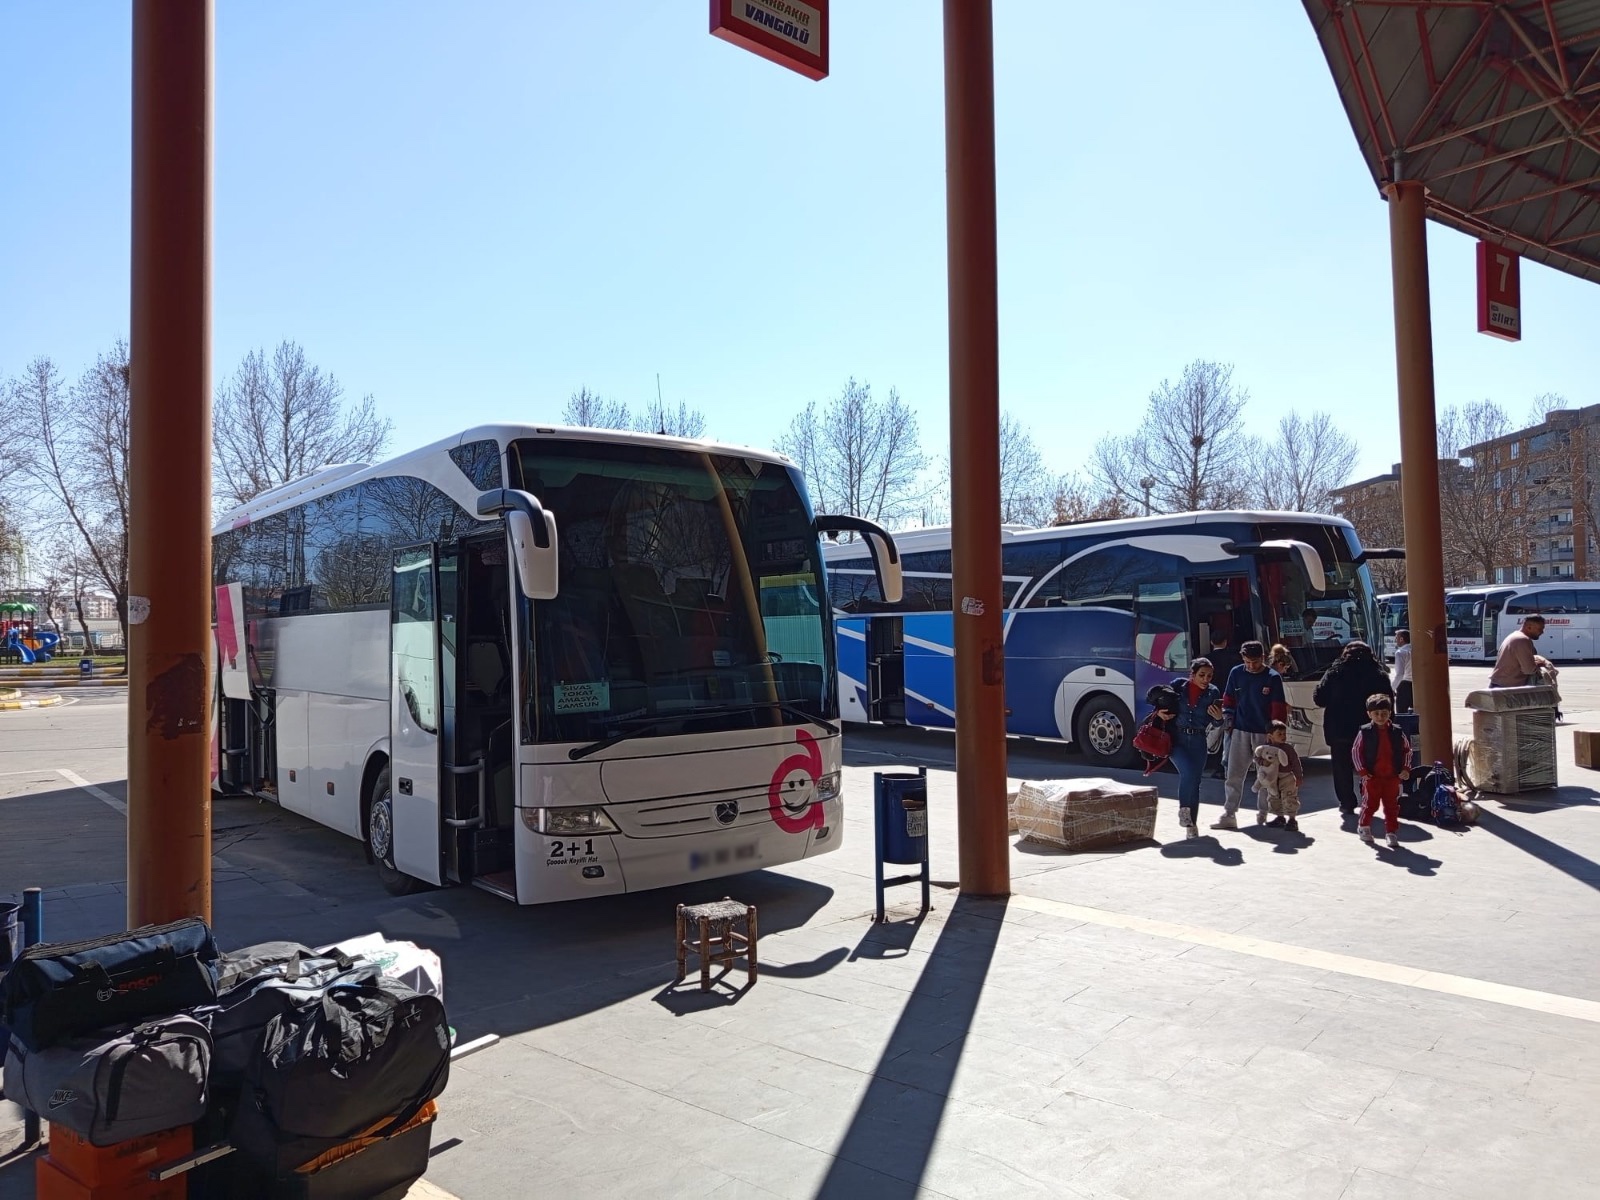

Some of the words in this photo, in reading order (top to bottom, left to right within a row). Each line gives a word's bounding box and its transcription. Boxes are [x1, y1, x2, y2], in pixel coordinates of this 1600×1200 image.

[745, 3, 810, 45] VANGÖLÜ
[1496, 253, 1510, 293] 7
[558, 695, 599, 704] AMASYA
[562, 689, 594, 697] TOKAT
[557, 701, 599, 710] SAMSUN
[551, 838, 594, 857] 2+1
